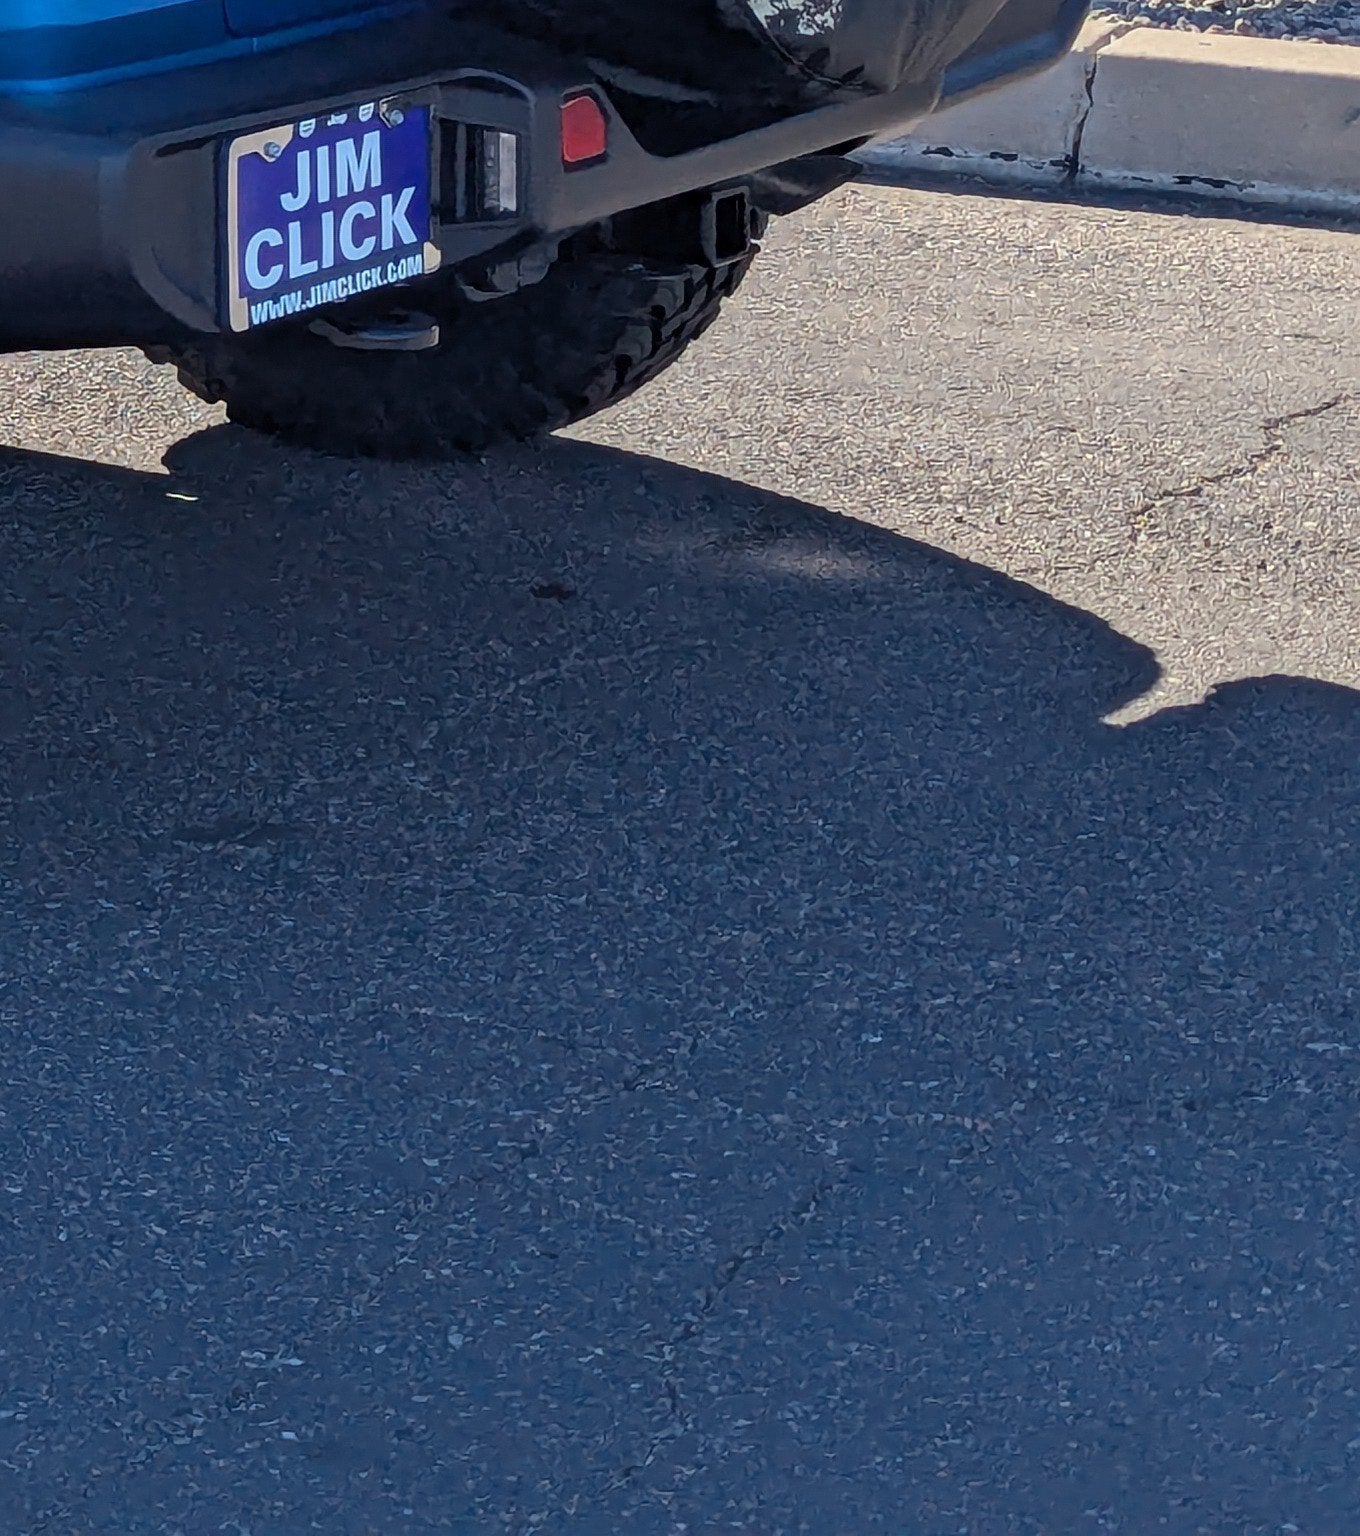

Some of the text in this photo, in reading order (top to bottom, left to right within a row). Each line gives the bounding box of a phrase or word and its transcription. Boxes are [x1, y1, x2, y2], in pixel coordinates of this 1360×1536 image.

[280, 129, 383, 213] JIM
[244, 185, 419, 291] CLICK
[250, 253, 424, 325] WWW.JIMCLICK.COM
